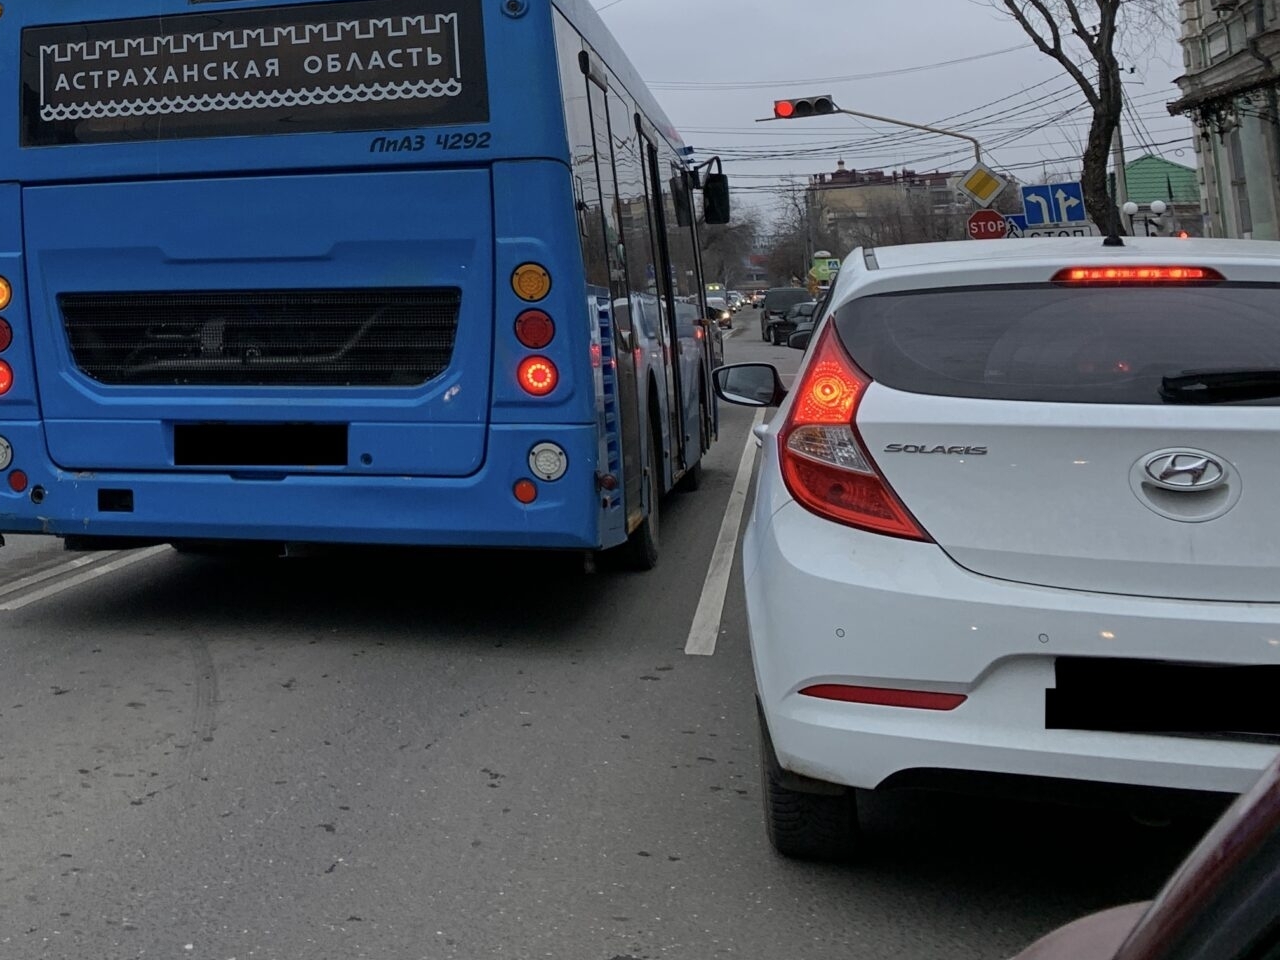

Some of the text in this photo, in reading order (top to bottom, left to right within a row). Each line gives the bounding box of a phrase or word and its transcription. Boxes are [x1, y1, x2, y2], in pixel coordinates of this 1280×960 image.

[54, 46, 443, 91] АСТРАХАНСКАЯ ОБЛАСТЬ
[435, 131, 492, 151] 4292
[970, 220, 1005, 234] STOP
[883, 444, 988, 455] SOLARIS
